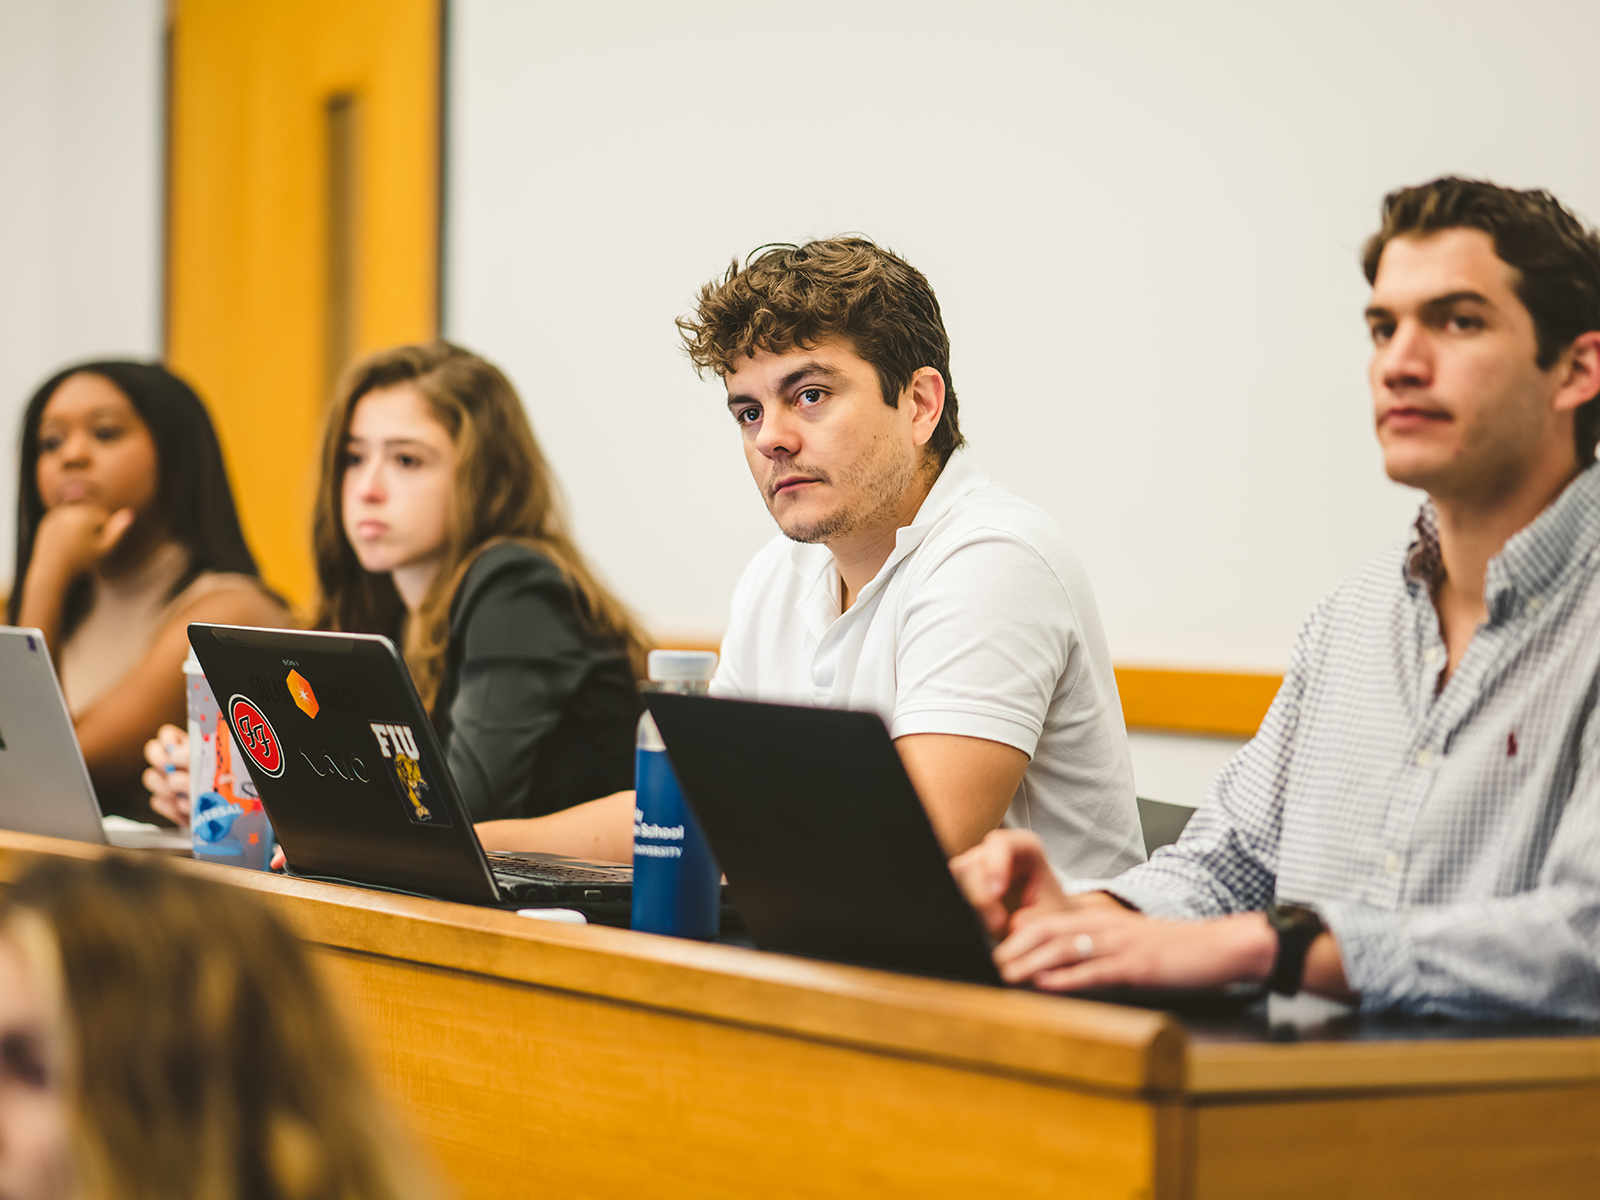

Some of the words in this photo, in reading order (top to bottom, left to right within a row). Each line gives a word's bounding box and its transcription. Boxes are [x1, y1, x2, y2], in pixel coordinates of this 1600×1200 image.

[281, 658, 299, 666] SONY
[370, 723, 420, 761] FIU
[640, 822, 684, 840] School
[634, 843, 683, 858] NIVERSITY
